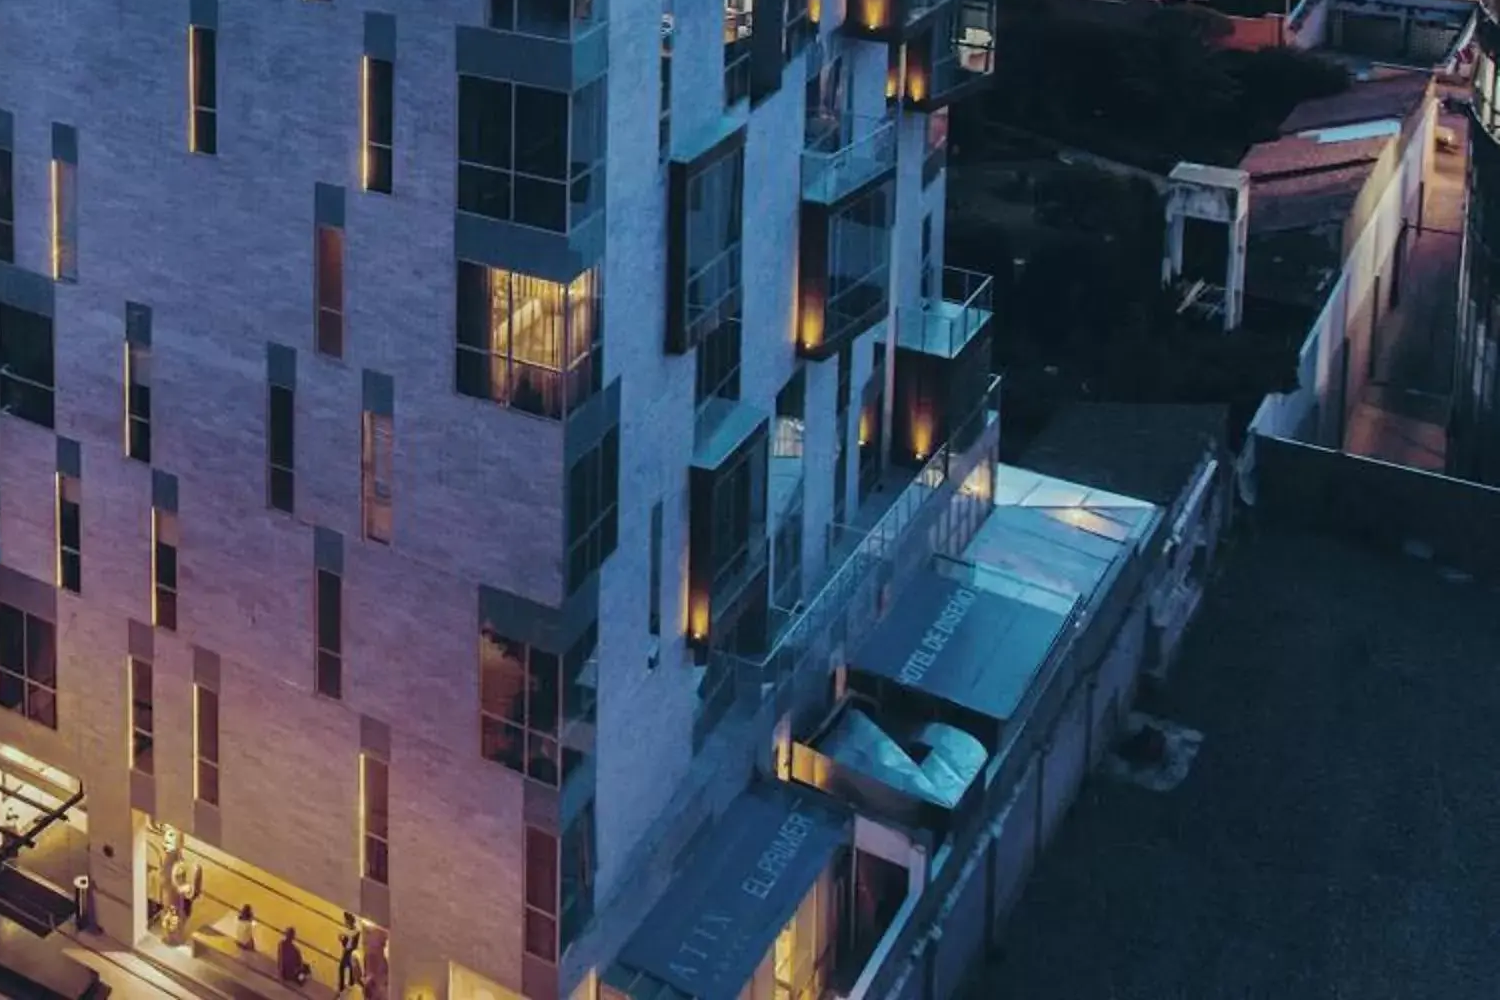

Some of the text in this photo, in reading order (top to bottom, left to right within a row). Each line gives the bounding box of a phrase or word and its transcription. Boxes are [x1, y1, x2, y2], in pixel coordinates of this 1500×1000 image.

[895, 649, 937, 685] HOTEL
[922, 629, 949, 652] DE
[741, 876, 777, 900] EL
